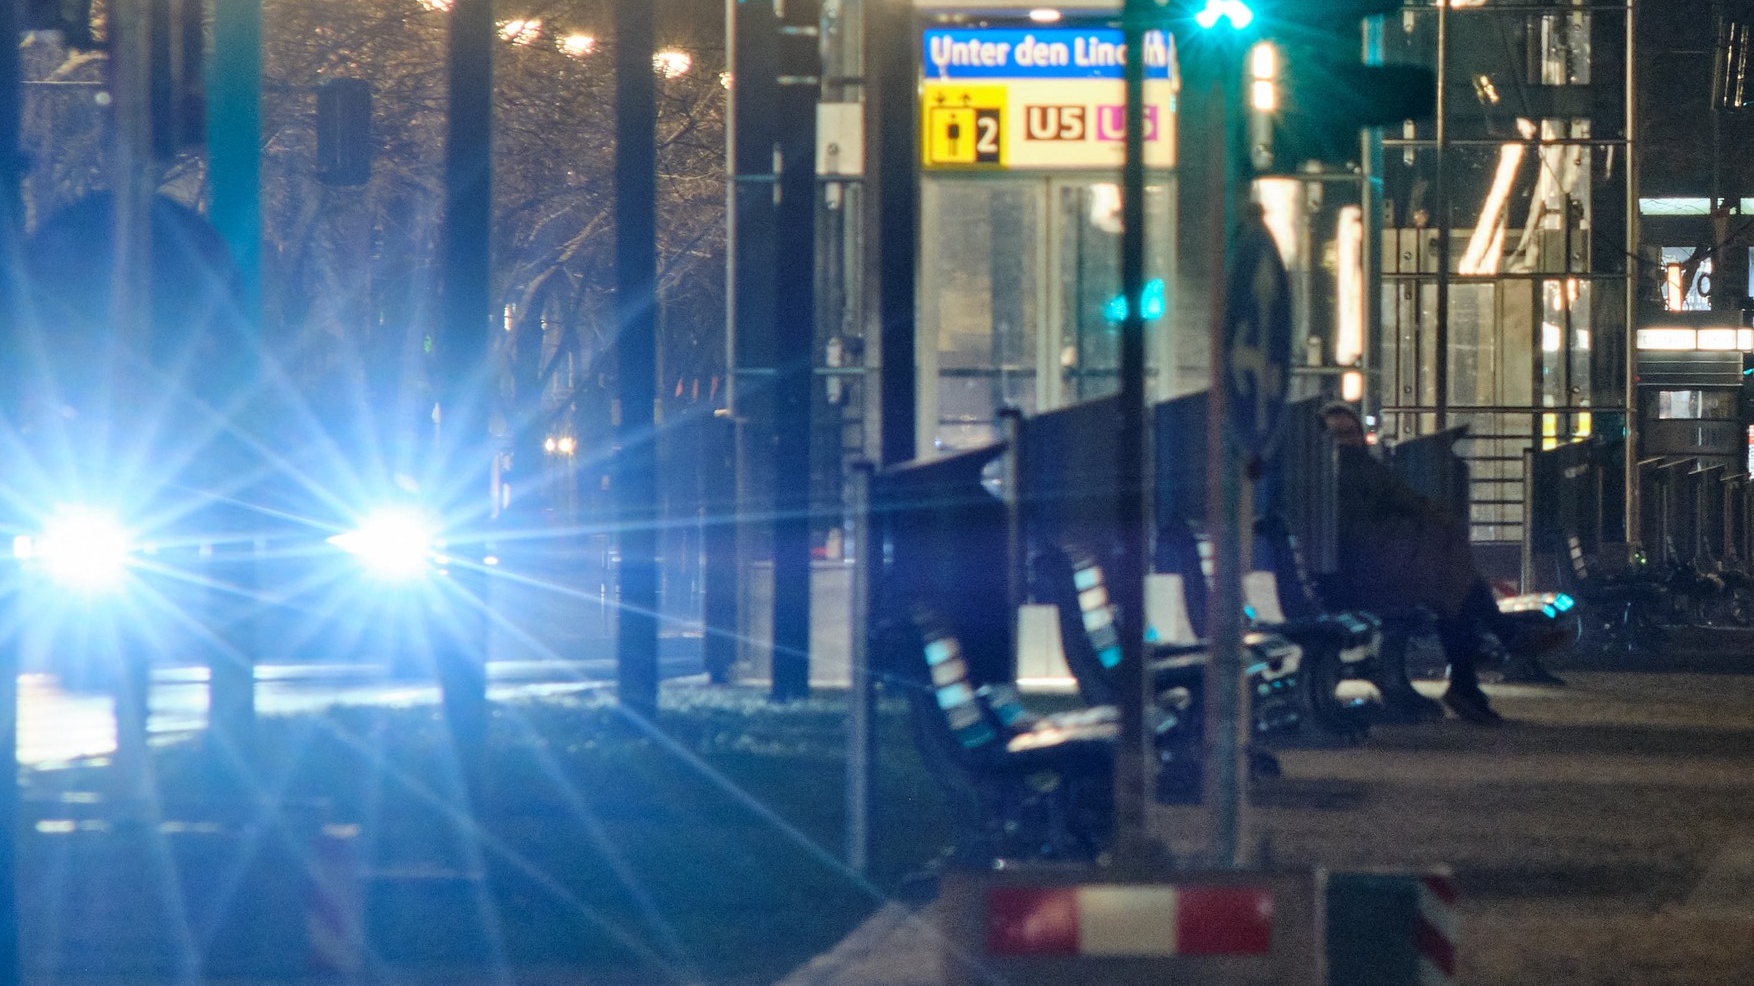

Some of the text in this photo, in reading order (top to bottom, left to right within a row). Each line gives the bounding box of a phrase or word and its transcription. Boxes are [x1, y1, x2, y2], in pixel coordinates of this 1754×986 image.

[930, 34, 1168, 67] Unter den Linn
[976, 116, 999, 153] 2
[1028, 106, 1085, 140] U5
